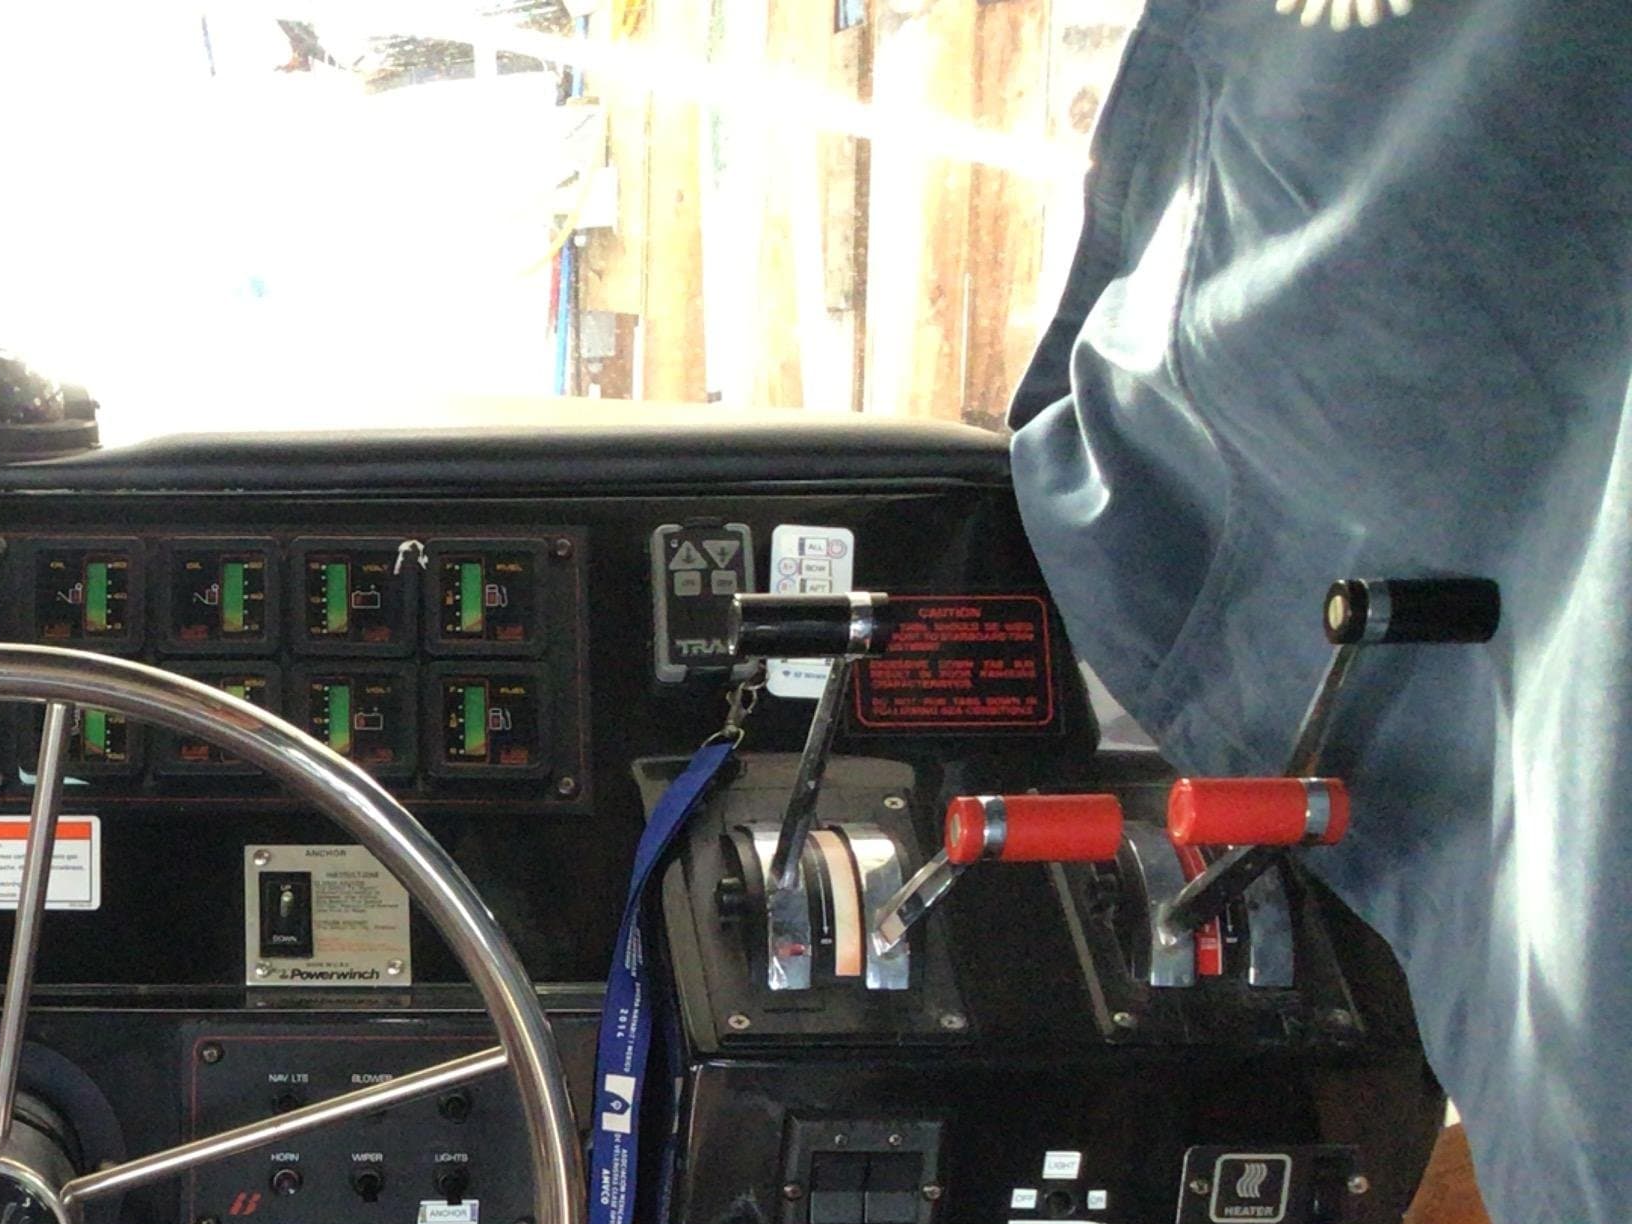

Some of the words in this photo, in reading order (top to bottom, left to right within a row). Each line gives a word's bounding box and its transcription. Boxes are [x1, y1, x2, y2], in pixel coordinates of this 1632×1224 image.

[918, 608, 982, 618] CAUTION
[675, 639, 729, 656] TRA
[305, 849, 347, 857] ANCHOR
[290, 968, 379, 981] Powerwinch
[269, 1074, 290, 1083] NAV
[271, 1153, 300, 1162] HORN
[352, 1153, 383, 1162] WIPER
[435, 1153, 468, 1162] LIGHTS
[1049, 1161, 1075, 1170] LIGHT
[1014, 1194, 1034, 1203] OFF
[429, 1208, 468, 1218] ANCHOR
[1223, 1205, 1274, 1216] HEATER
